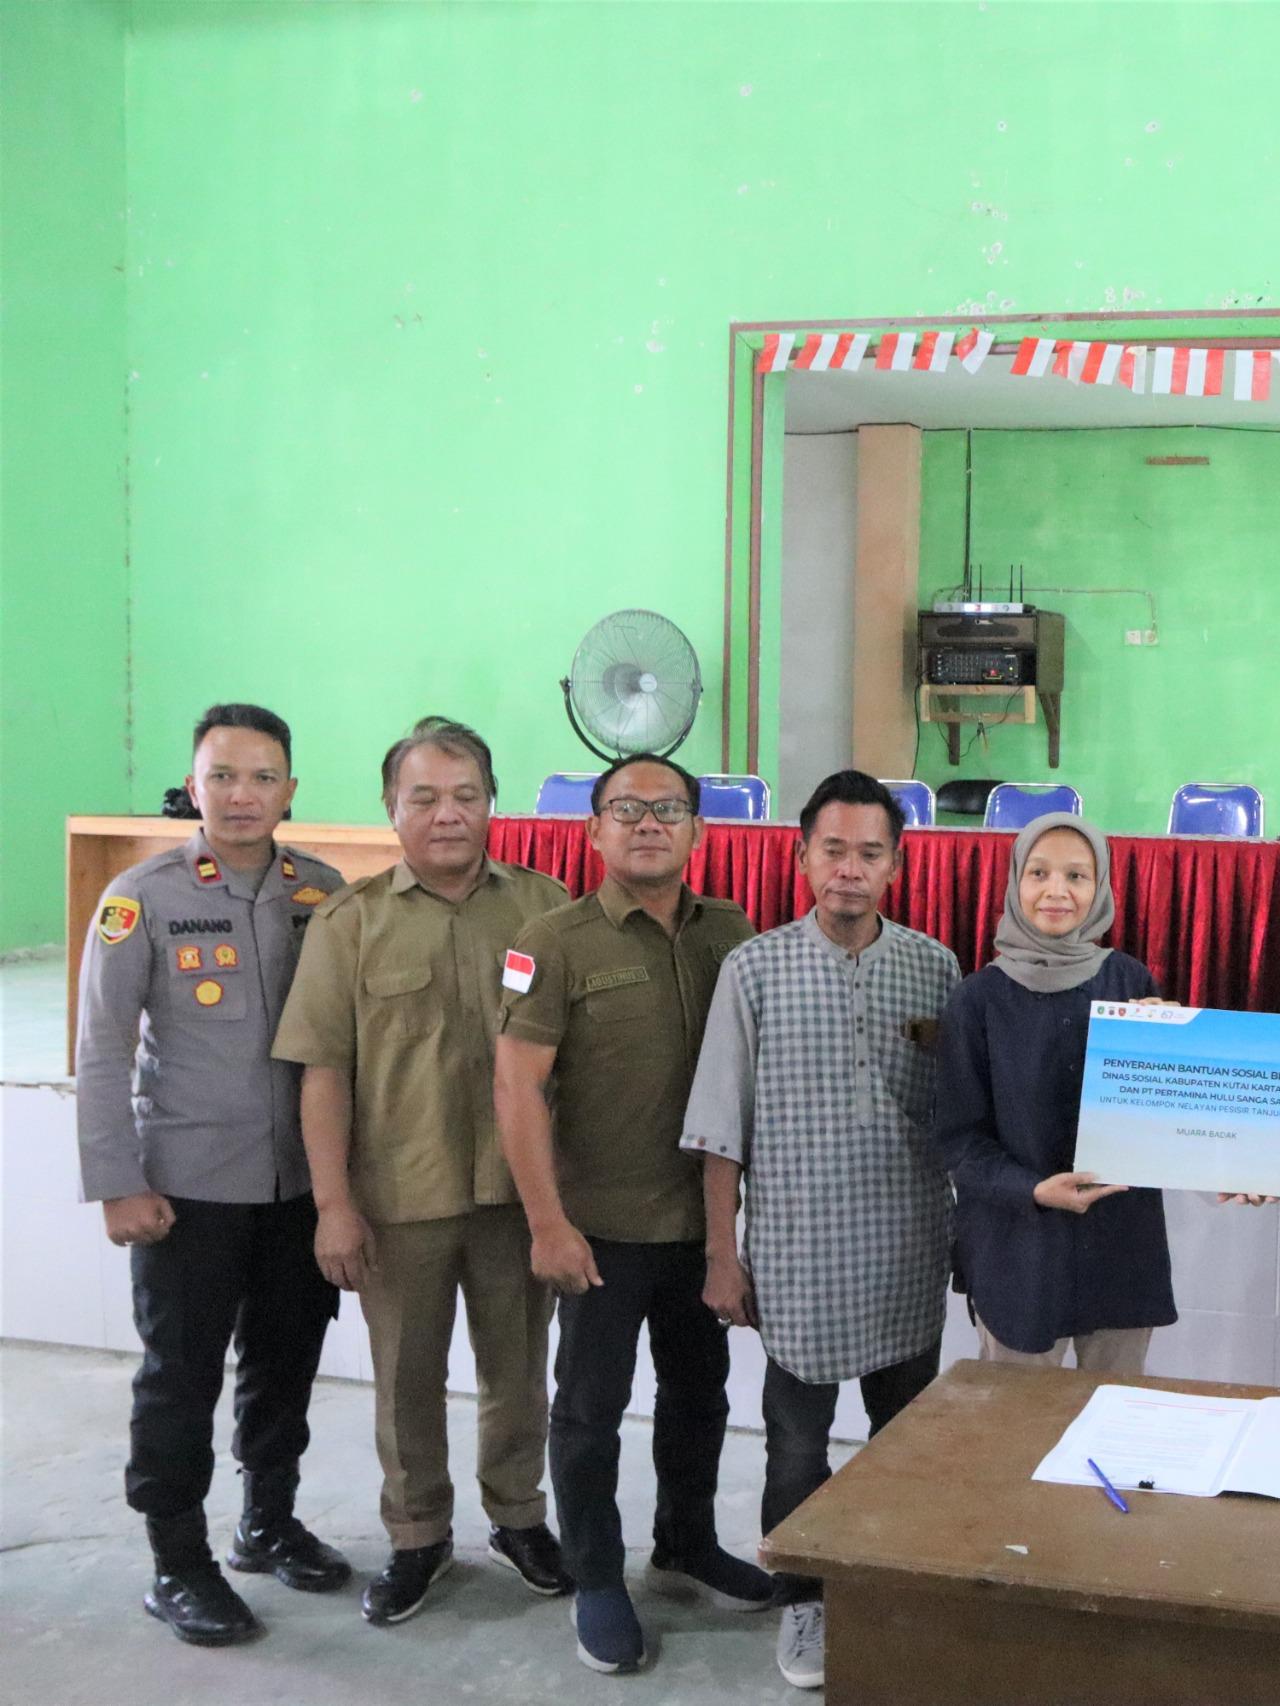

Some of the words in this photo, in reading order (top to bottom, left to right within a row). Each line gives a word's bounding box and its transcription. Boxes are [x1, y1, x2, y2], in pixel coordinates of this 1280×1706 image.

[169, 919, 233, 935] DANANG
[1103, 1058, 1175, 1072] PENYERAHAN
[1178, 1064, 1230, 1076] BANTUAN
[1232, 1068, 1268, 1080] SOSIAL
[1102, 1071, 1130, 1081] DINAS
[1131, 1074, 1163, 1084] SOSIAL
[1165, 1076, 1220, 1088] KABUPATEN
[1222, 1081, 1249, 1091] KUTAI
[1119, 1085, 1140, 1095] DAN
[1141, 1087, 1153, 1095] PT
[1154, 1088, 1208, 1100] PERTAMINA
[1209, 1093, 1234, 1102] HULU
[1237, 1096, 1268, 1105] SANGA
[1100, 1096, 1128, 1104] UNTUK
[1130, 1098, 1175, 1109] KELOMPOK
[1177, 1102, 1217, 1112] NELAYAN
[1219, 1106, 1249, 1115] PESISIR
[1176, 1128, 1207, 1137] MUARA
[1208, 1130, 1238, 1139] BADAK
